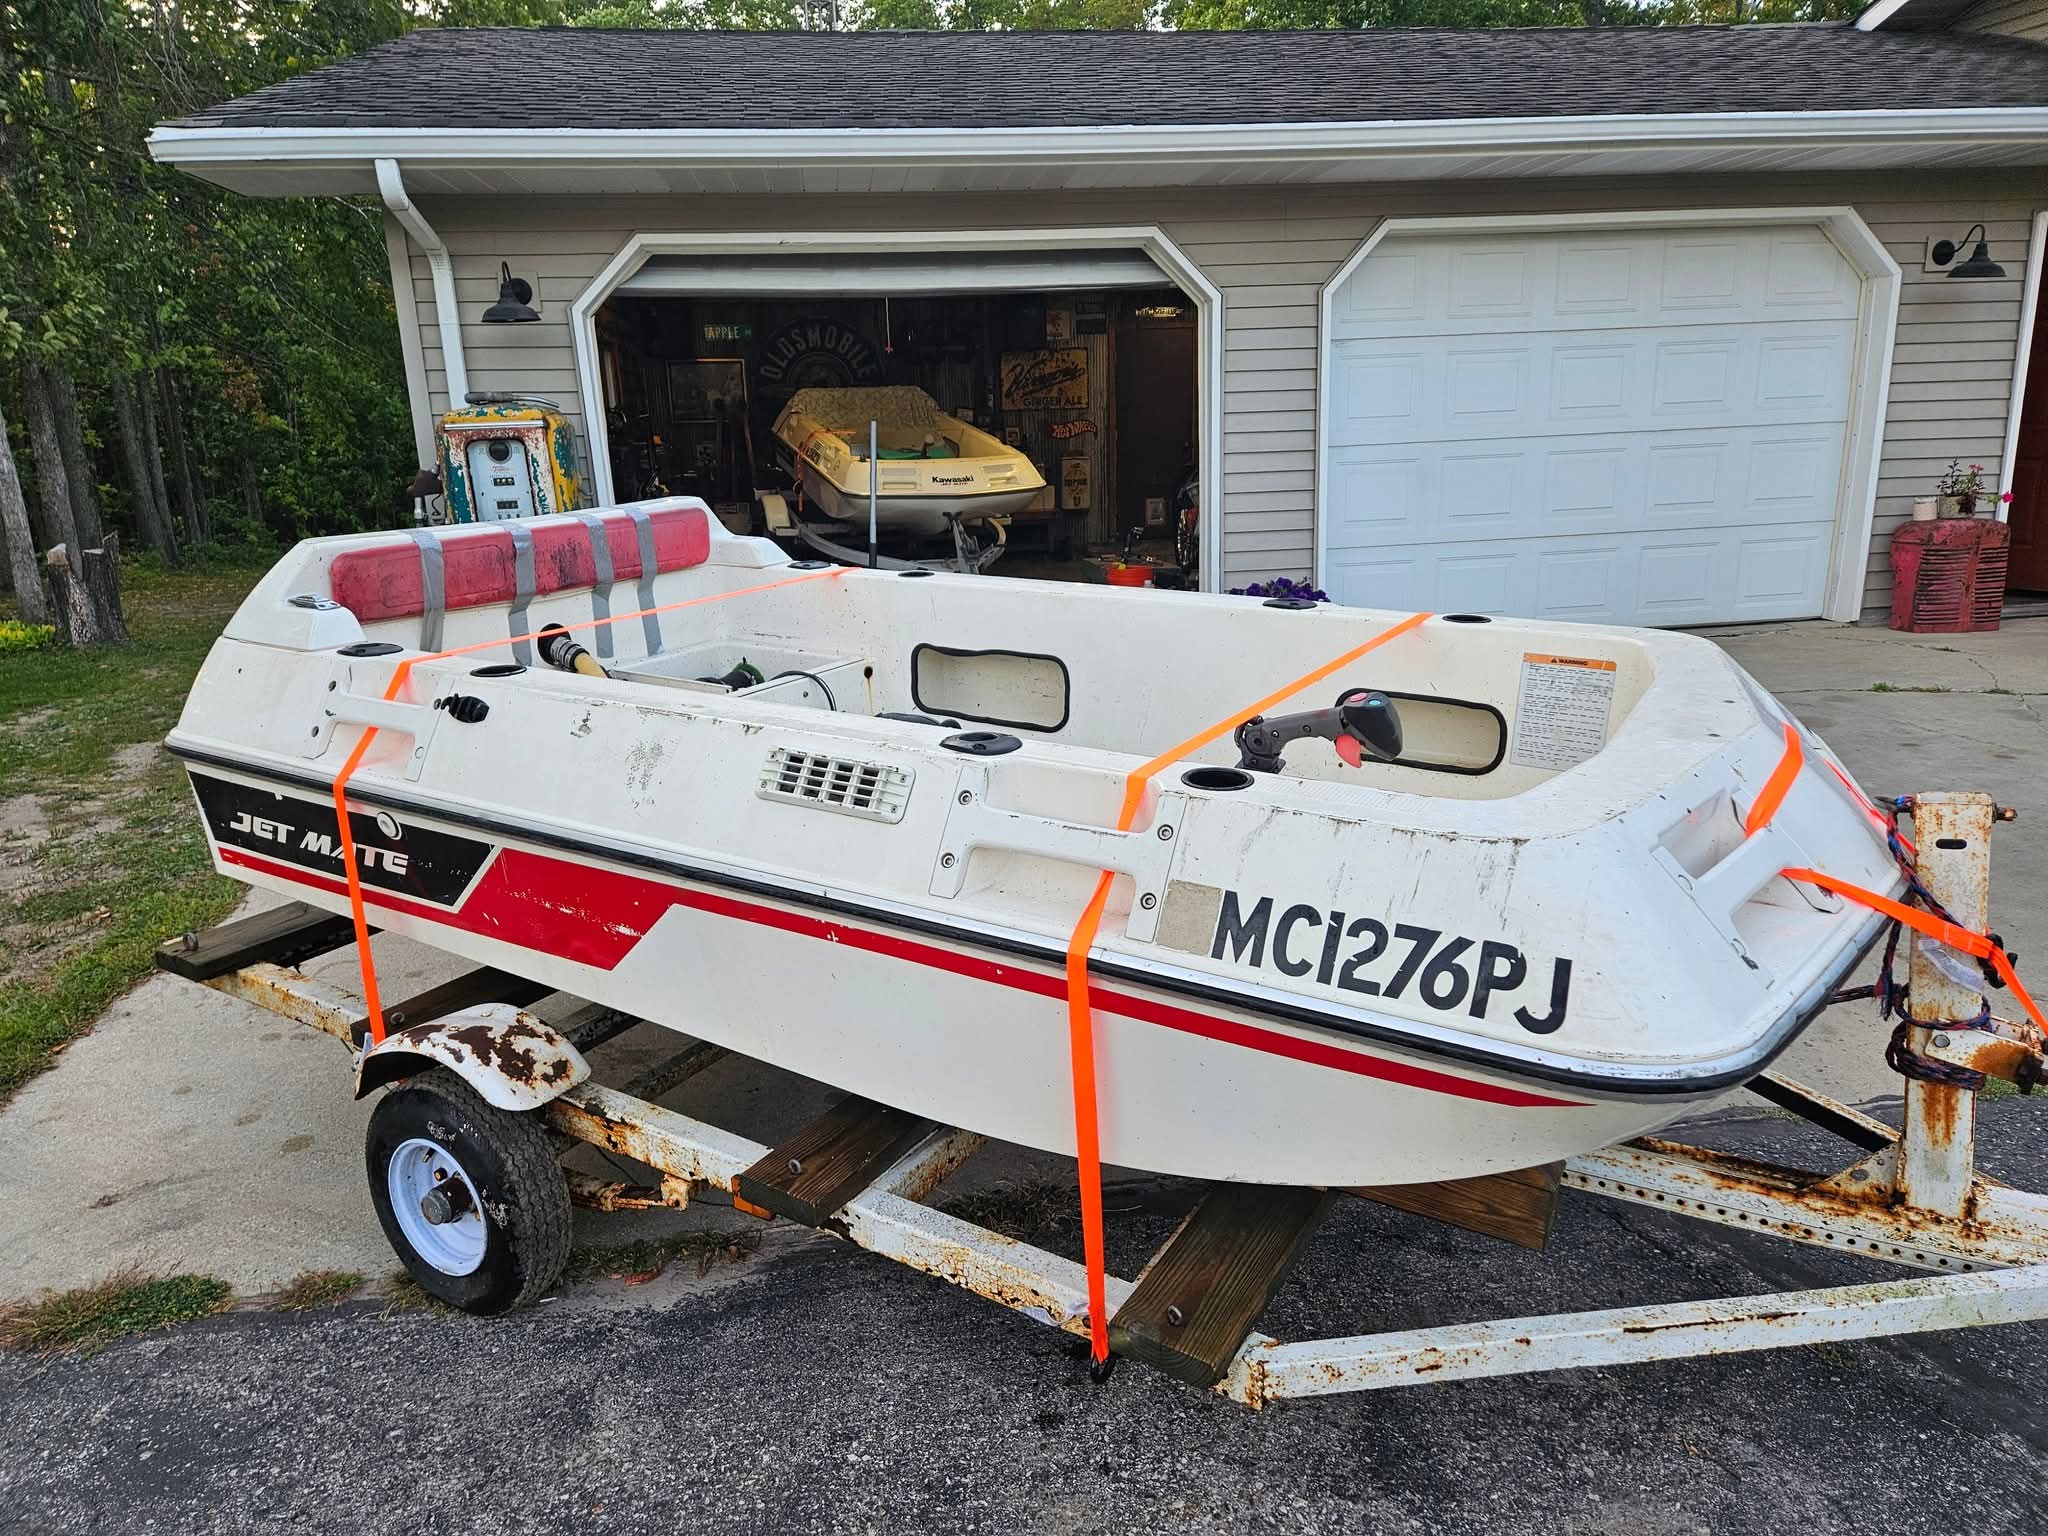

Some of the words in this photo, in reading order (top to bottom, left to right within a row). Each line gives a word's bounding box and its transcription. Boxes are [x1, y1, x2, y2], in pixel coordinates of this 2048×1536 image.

[760, 325, 878, 381] OLDSMOBILE
[1024, 396, 1062, 407] GINGER
[932, 475, 975, 483] Kawasaki
[1558, 658, 1588, 667] WARNING
[230, 812, 295, 844] JET
